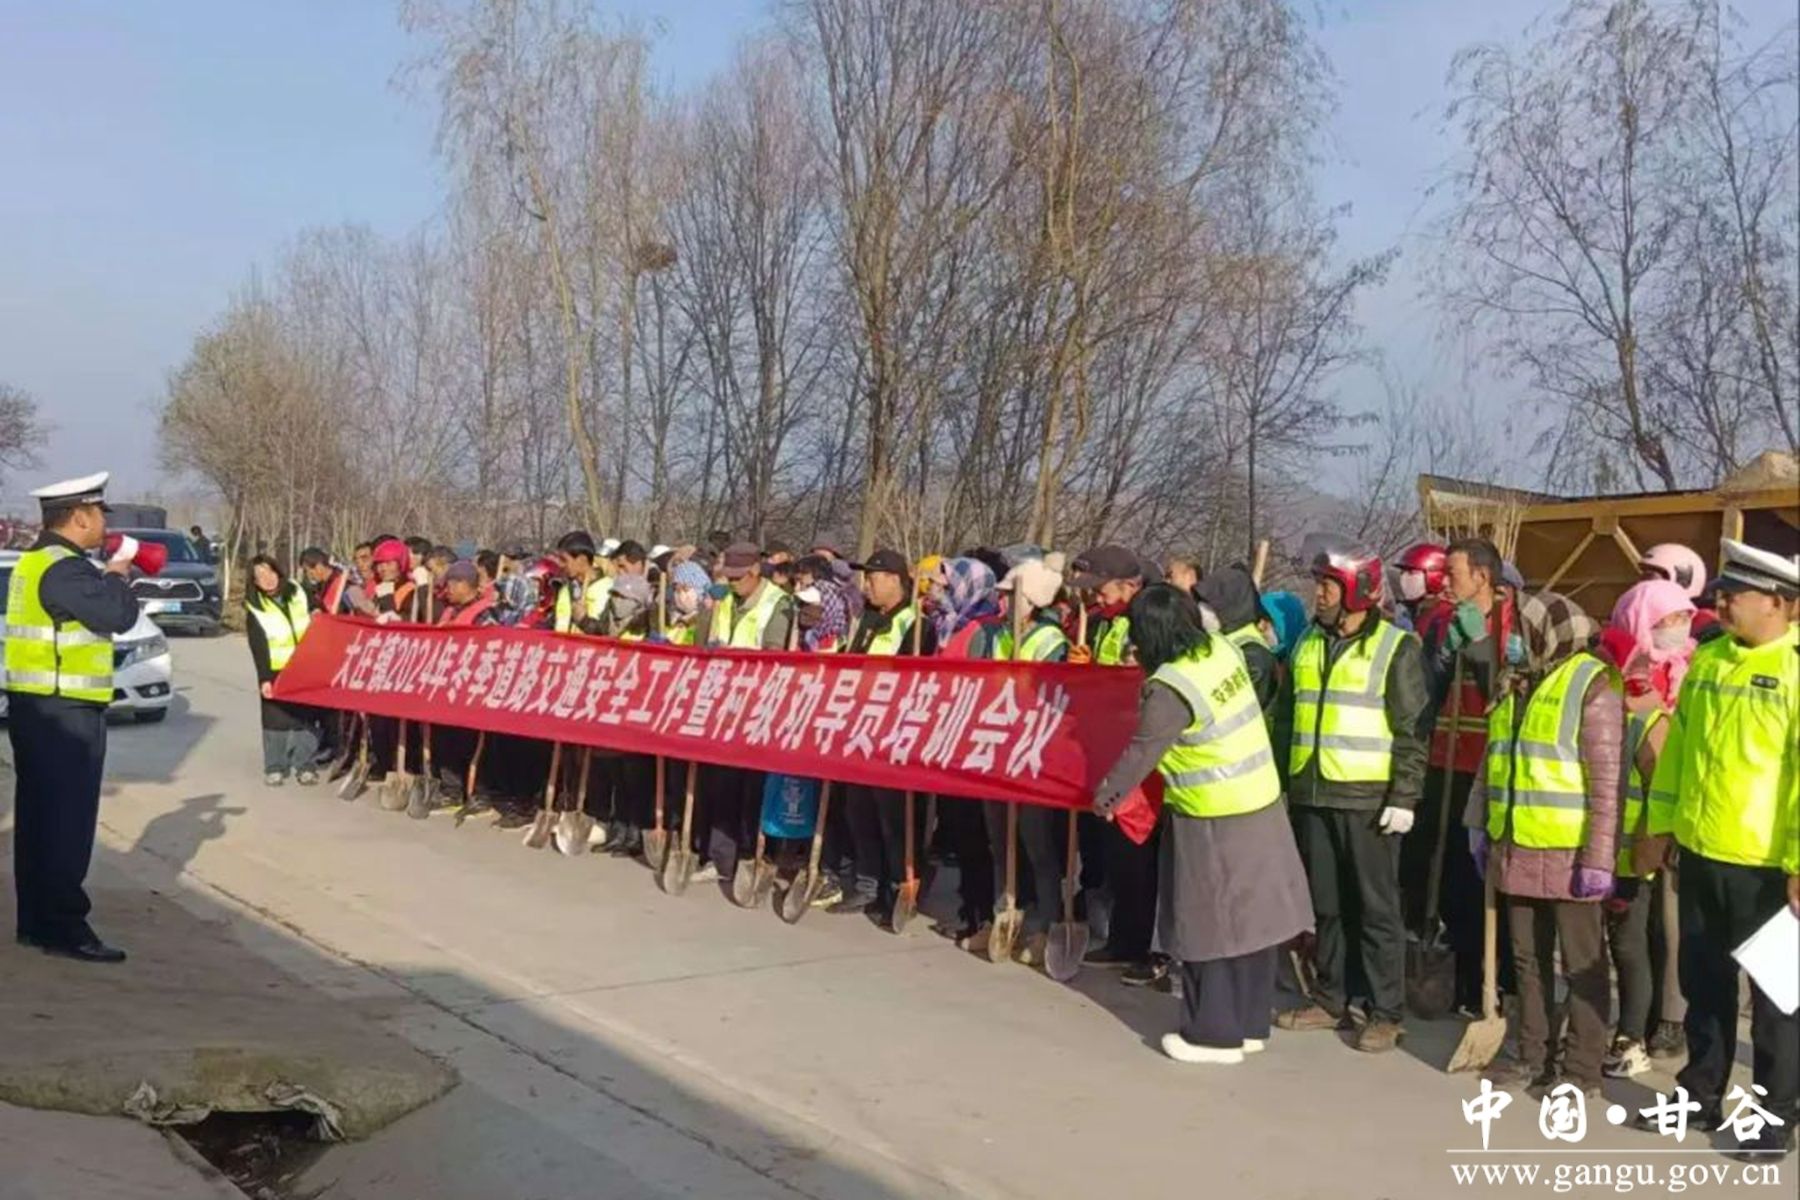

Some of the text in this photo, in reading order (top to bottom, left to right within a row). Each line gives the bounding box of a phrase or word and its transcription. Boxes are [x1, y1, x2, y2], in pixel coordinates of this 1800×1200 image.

[331, 630, 1070, 779] 大庄镇2024年冬季道路交通安全工作暨村级劝导员培训会议
